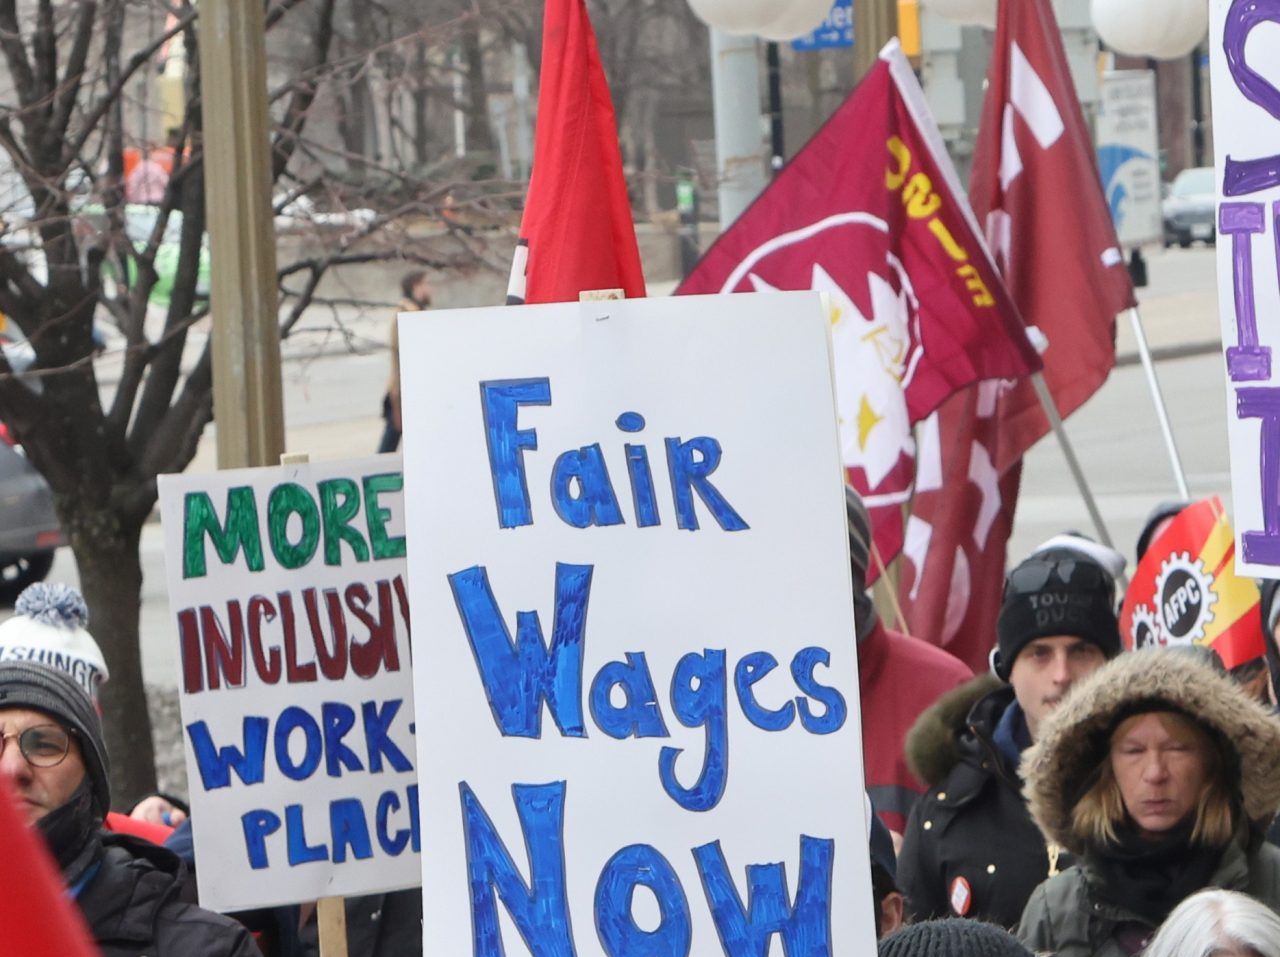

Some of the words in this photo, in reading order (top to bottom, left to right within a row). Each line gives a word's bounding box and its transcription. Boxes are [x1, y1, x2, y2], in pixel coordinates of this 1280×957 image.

[182, 472, 406, 579] MORE
[1163, 578, 1201, 629] AFPC
[447, 562, 847, 811] Wages
